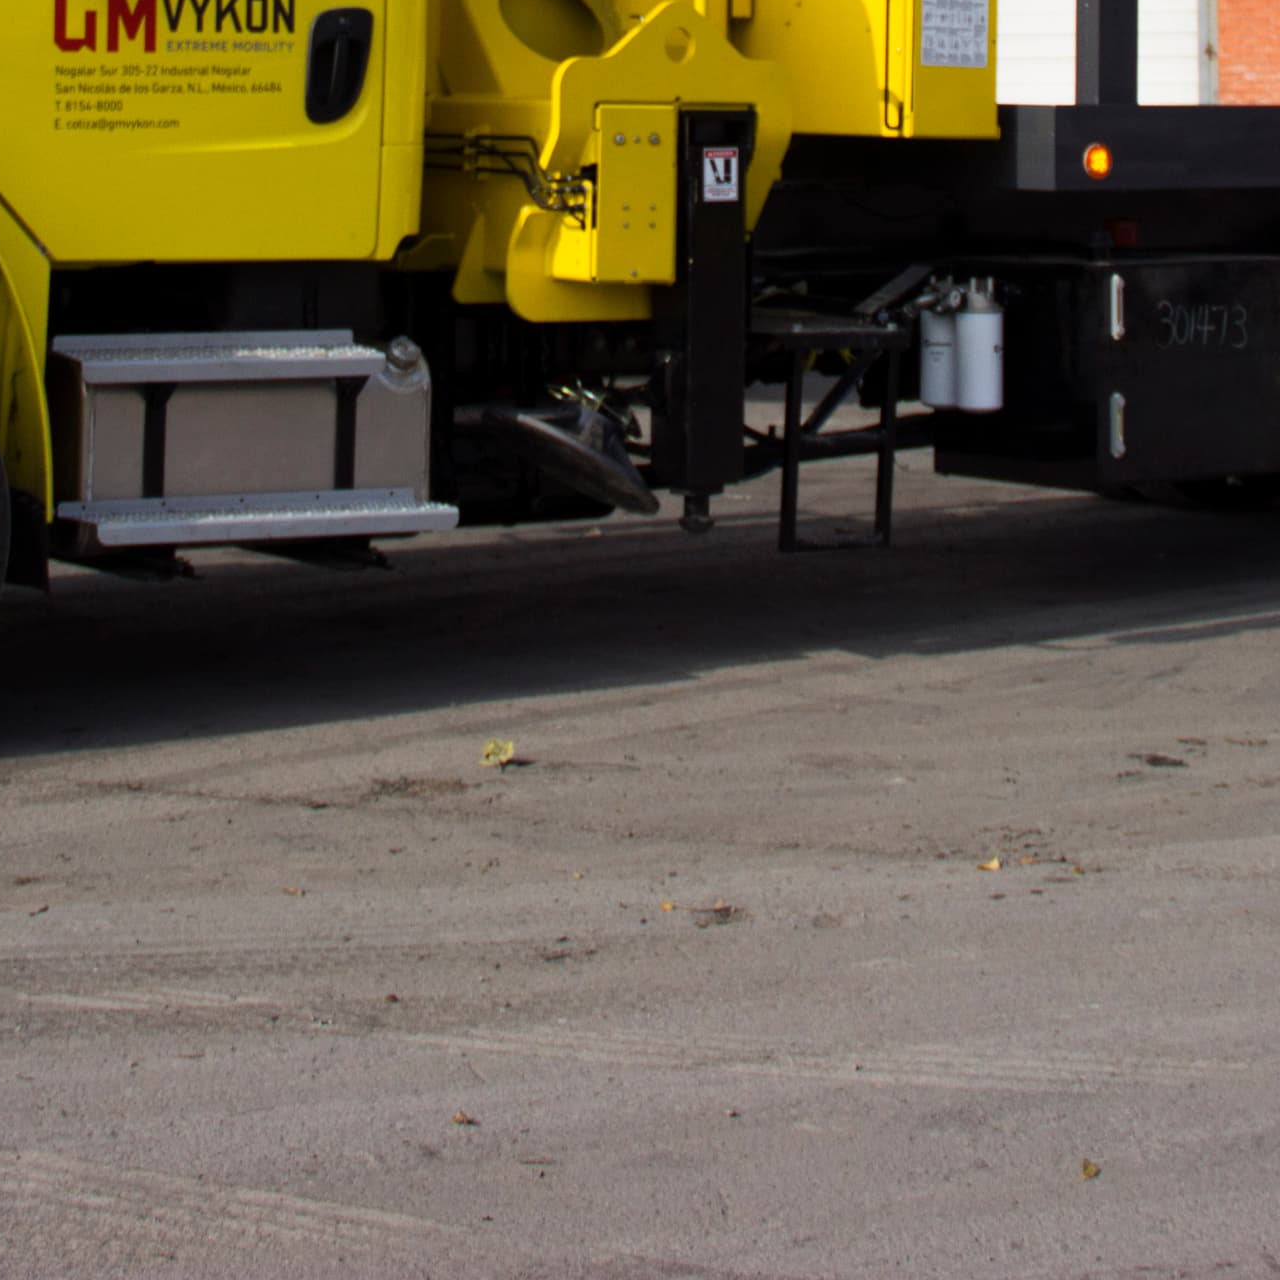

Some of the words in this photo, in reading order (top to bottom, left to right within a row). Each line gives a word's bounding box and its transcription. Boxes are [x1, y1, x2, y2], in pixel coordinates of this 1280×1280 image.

[165, 40, 228, 53] EXTREME
[232, 40, 295, 53] MOBILITY
[55, 64, 97, 79] Nogalar
[161, 64, 209, 77] Industrial
[211, 64, 252, 79] Nogalar
[55, 82, 76, 95] San
[119, 83, 131, 95] de
